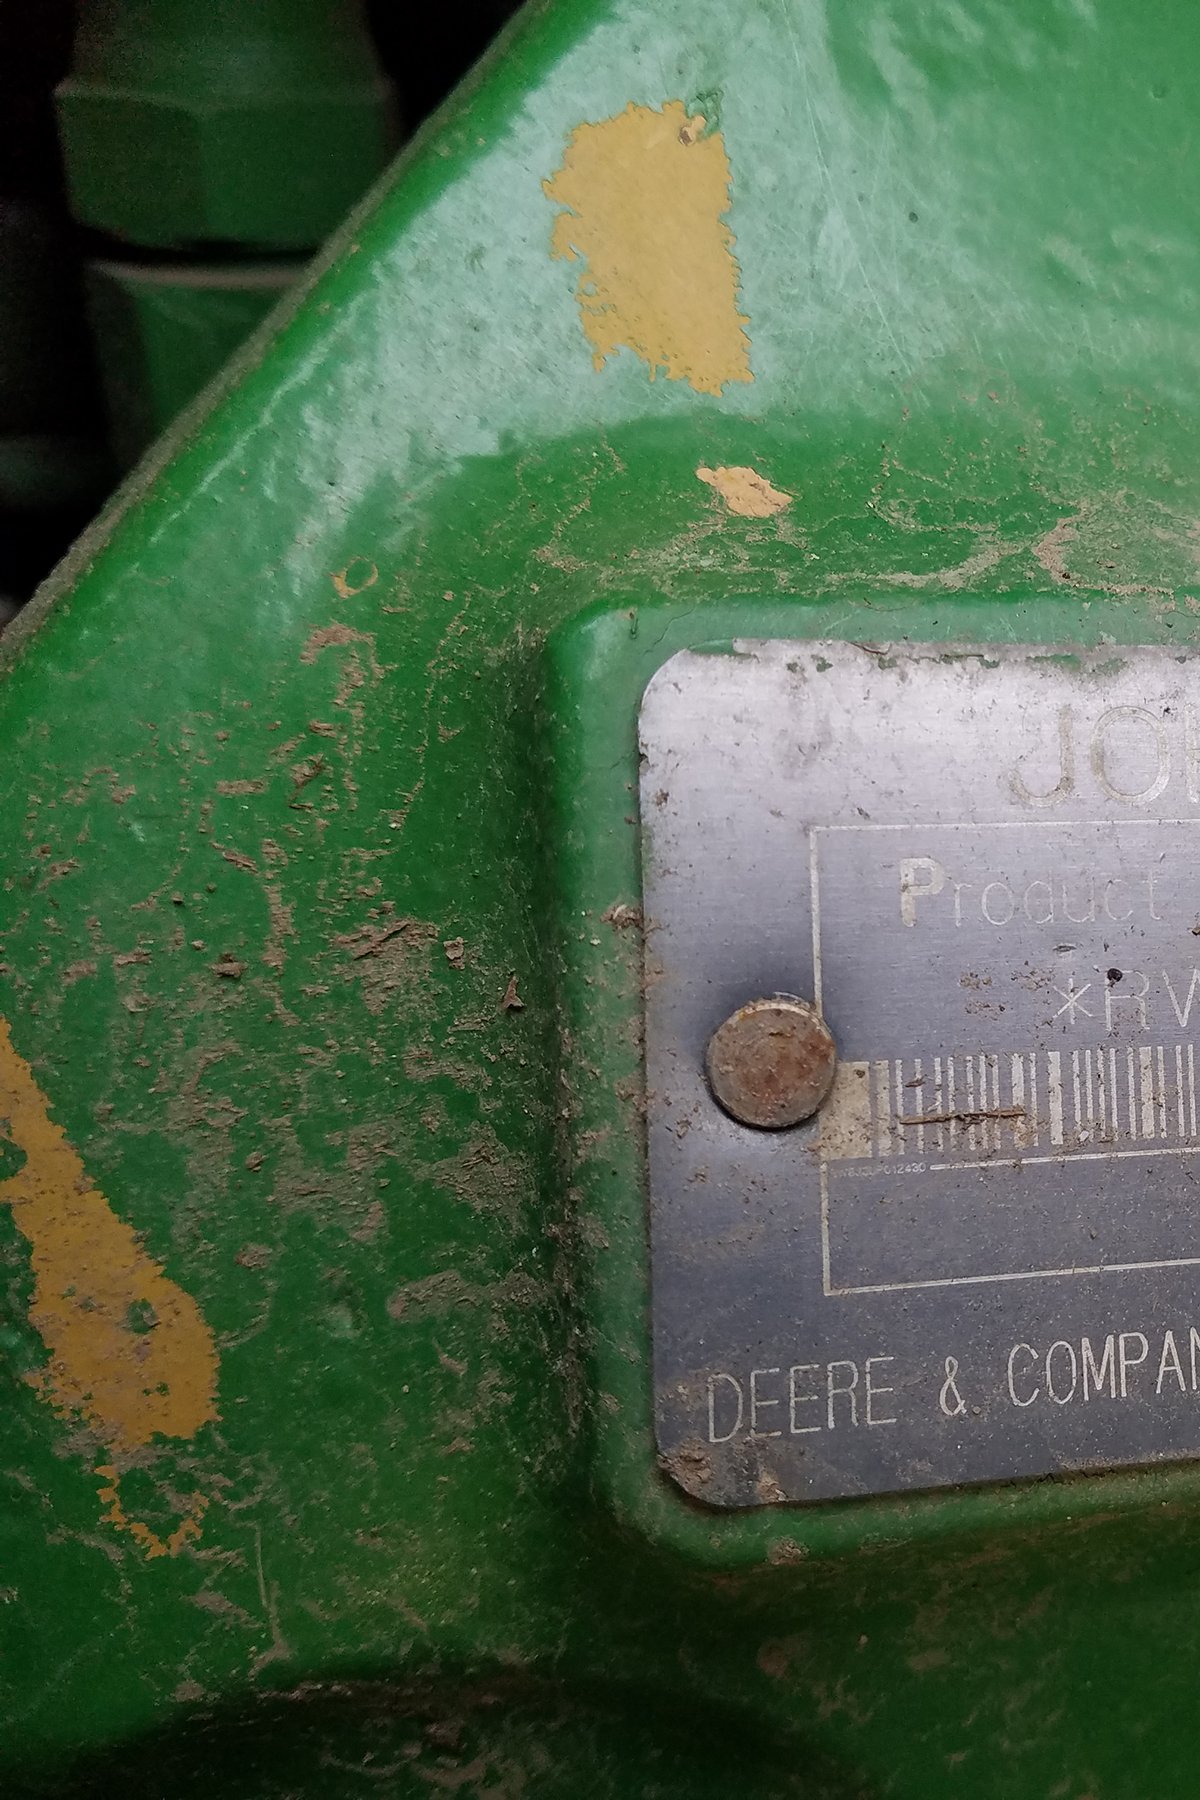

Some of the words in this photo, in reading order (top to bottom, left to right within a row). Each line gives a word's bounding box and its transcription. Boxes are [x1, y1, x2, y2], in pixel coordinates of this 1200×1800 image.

[900, 856, 1162, 928] Product
[706, 1355, 897, 1443] DEERE
[938, 1355, 967, 1416] &
